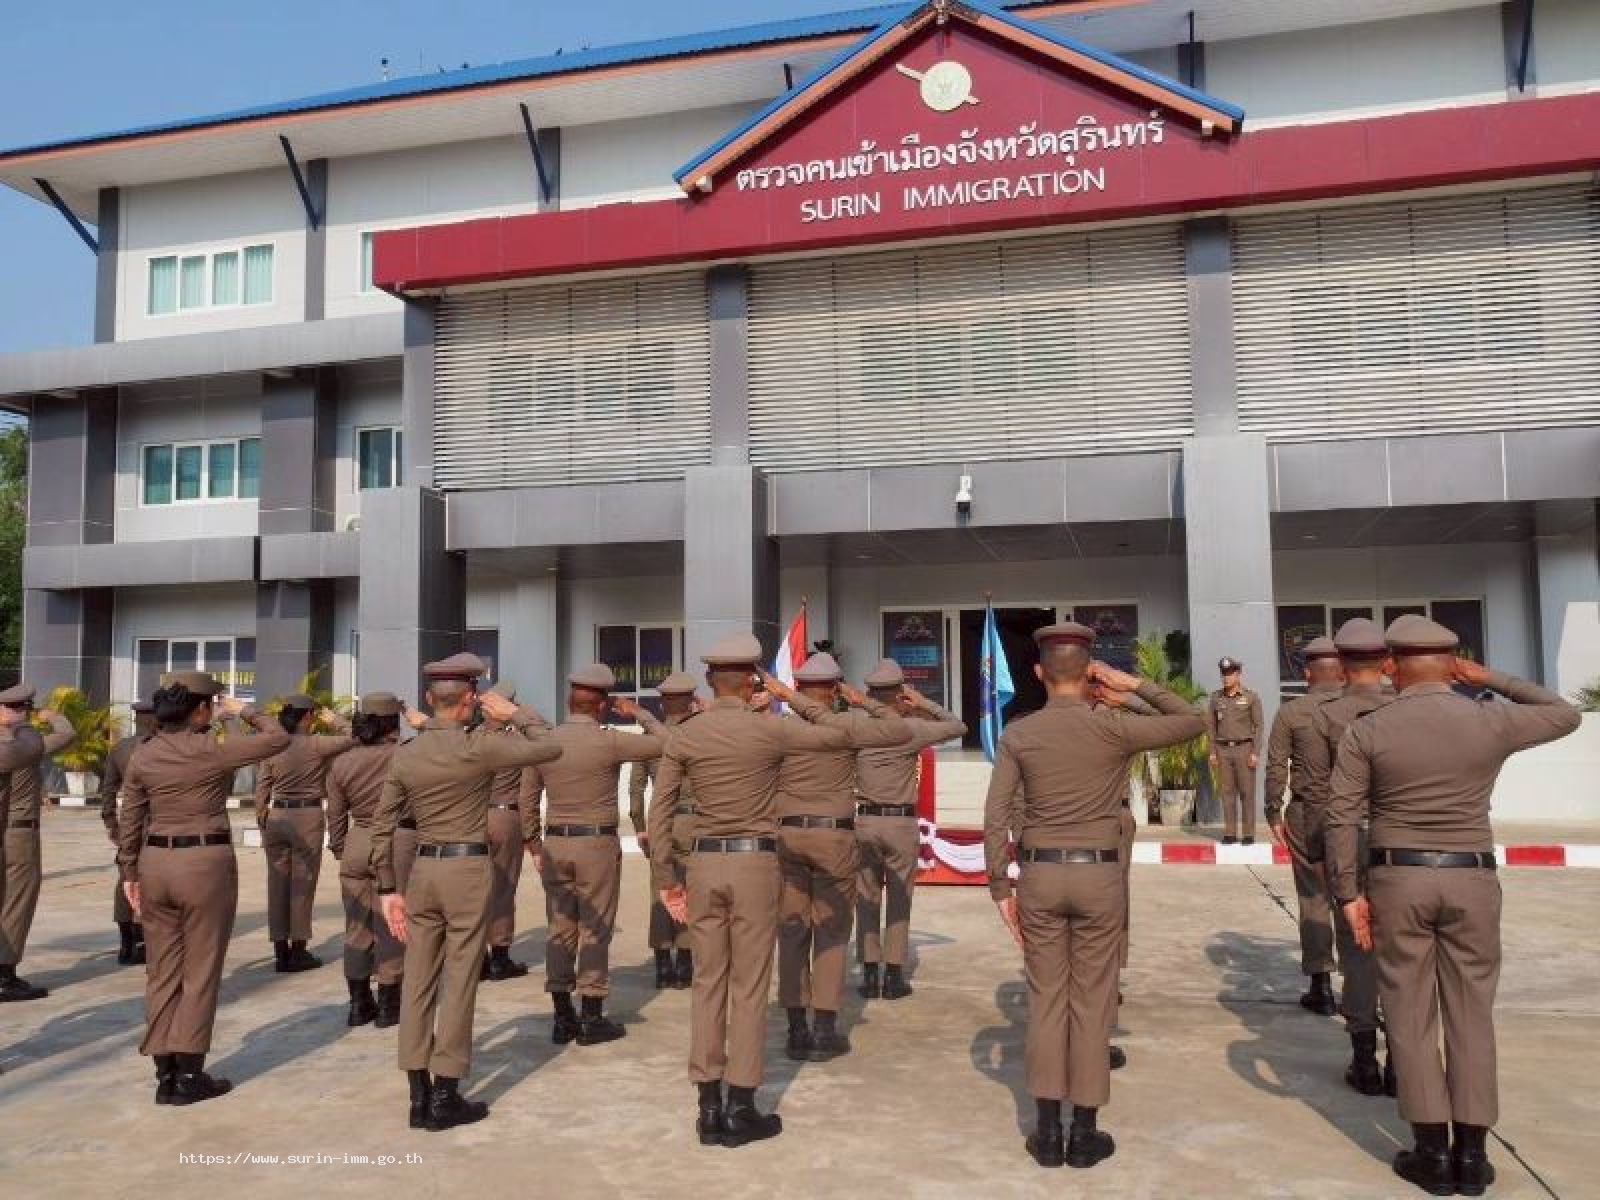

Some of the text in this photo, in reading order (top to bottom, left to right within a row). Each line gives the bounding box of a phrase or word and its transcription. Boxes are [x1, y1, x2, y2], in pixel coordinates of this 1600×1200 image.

[736, 110, 1164, 191] ตรวจคนเข้าเมืองจังหวัดสุรินทร์
[800, 167, 1105, 222] SURIN IMMIGRATION
